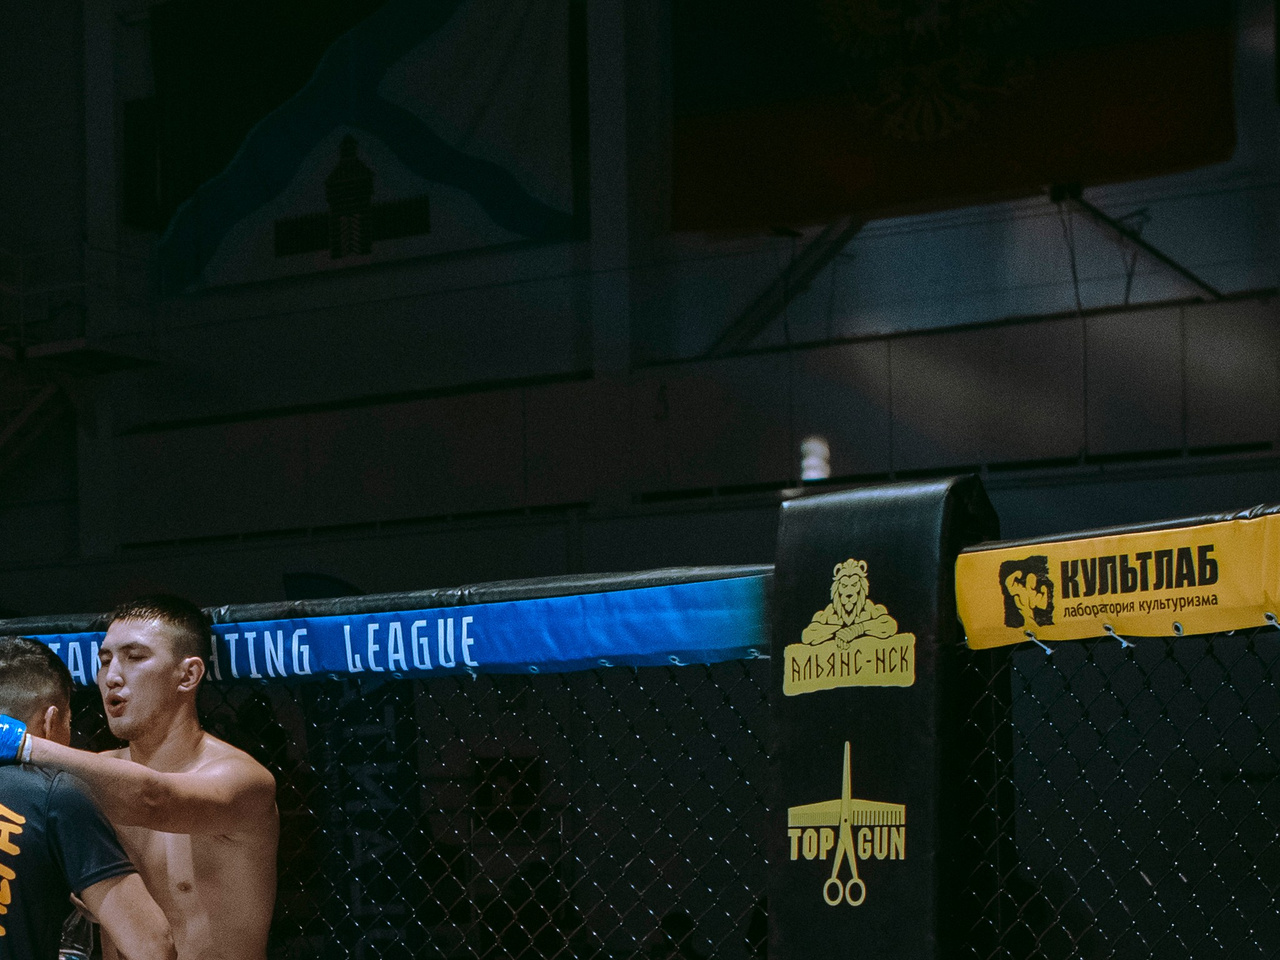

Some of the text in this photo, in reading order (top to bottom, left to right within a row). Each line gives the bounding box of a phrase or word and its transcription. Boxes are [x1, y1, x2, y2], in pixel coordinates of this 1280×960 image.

[1060, 544, 1219, 599] КУЛЬТЛАБ
[1063, 594, 1219, 618] лаборатория культуризма
[342, 616, 480, 672] LEAGUE
[791, 645, 909, 683] АЛЬЯНС-НСК
[787, 826, 906, 860] TOP GUN
